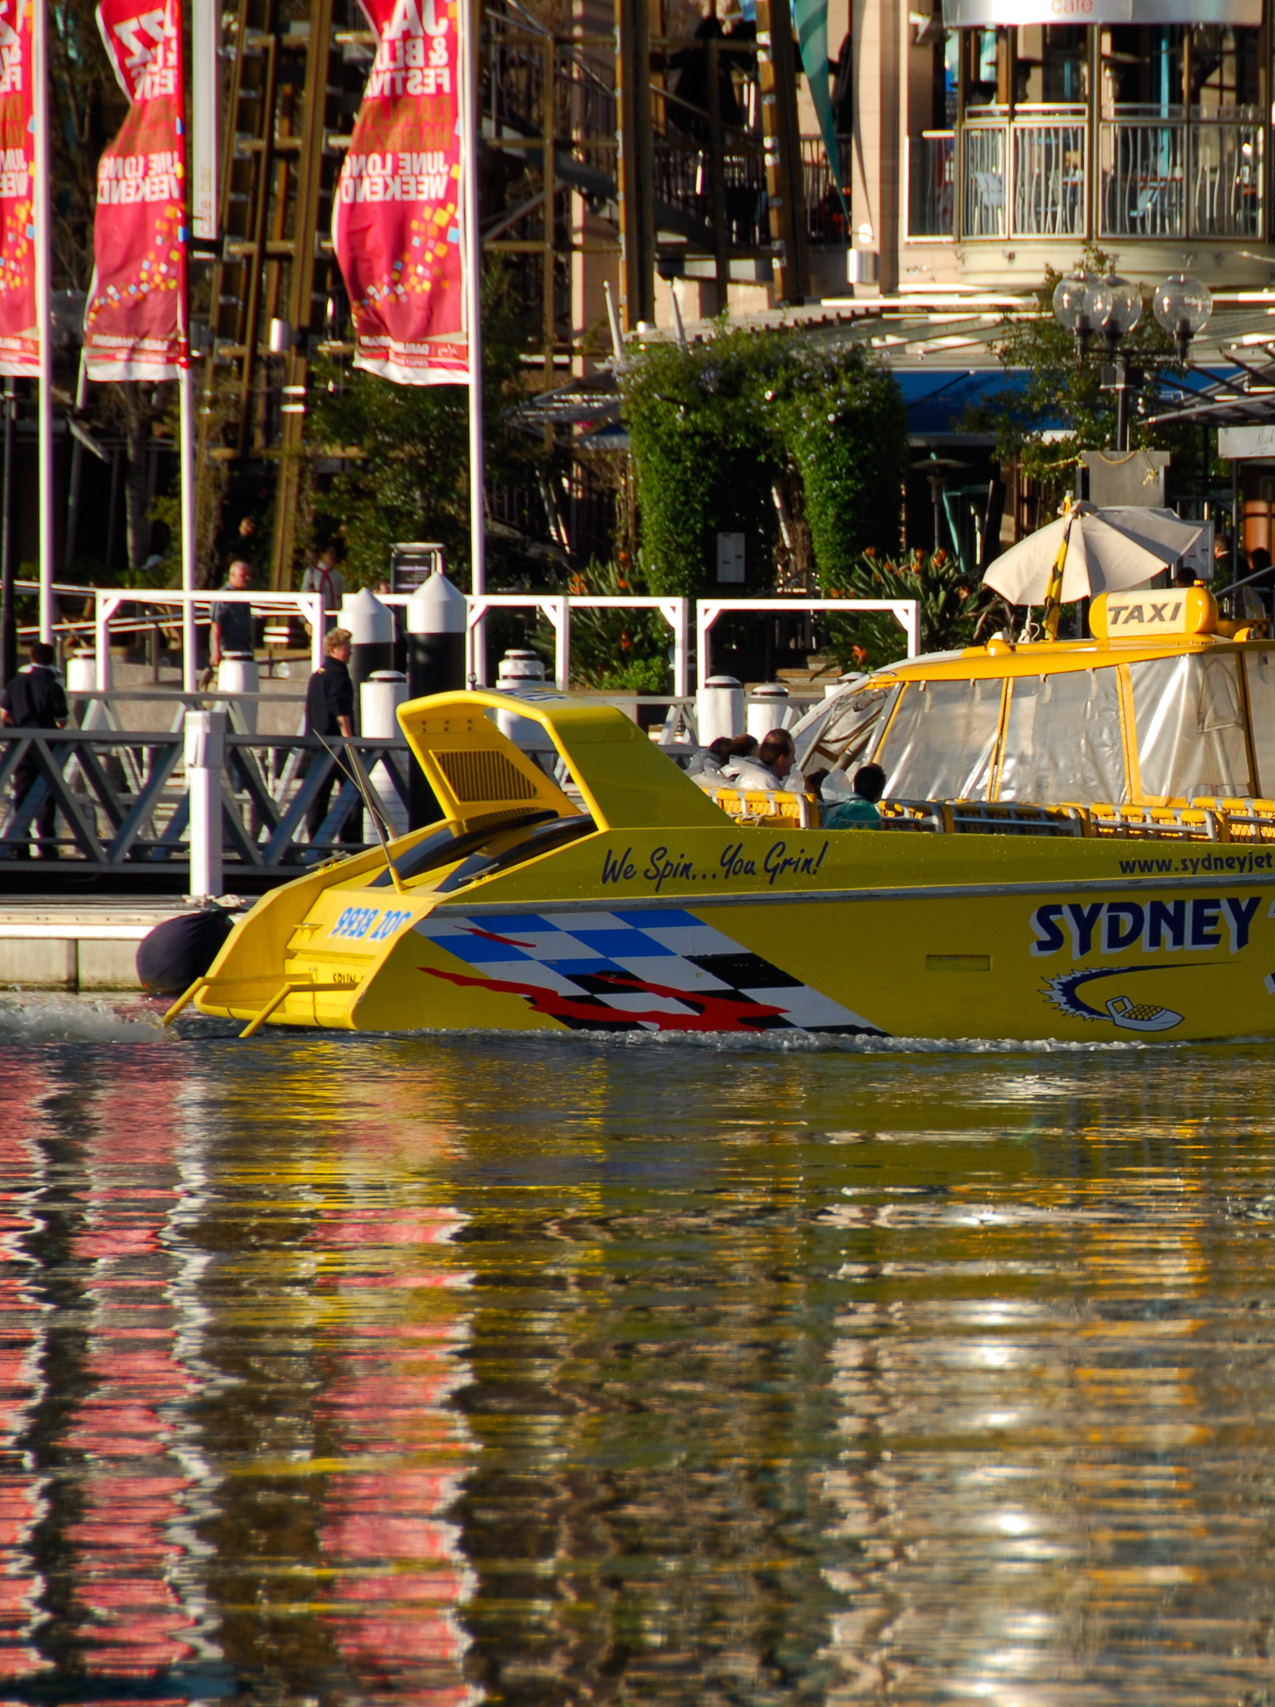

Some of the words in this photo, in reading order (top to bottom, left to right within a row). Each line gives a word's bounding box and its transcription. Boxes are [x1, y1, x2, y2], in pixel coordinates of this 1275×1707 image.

[1108, 602, 1182, 625] TAXI
[601, 847, 637, 884] We
[764, 840, 829, 885] Grin!
[329, 906, 379, 939] 9938
[1029, 897, 1262, 961] SYDNEY
